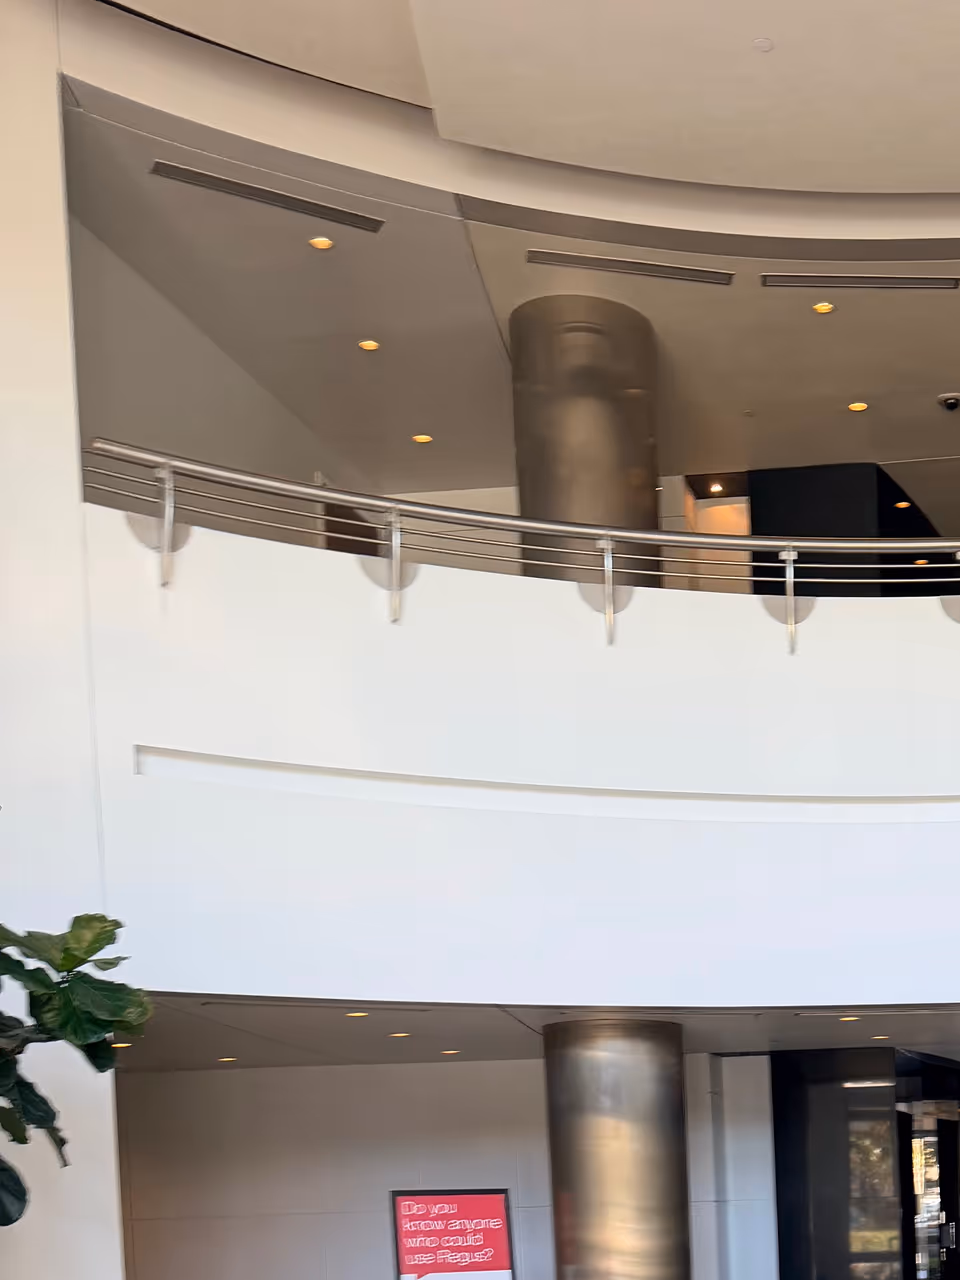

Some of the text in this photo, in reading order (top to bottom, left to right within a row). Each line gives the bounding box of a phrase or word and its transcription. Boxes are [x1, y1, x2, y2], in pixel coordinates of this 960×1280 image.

[401, 1201, 458, 1218] Do you
[402, 1218, 503, 1233] know anyone
[404, 1232, 484, 1248] who could
[405, 1248, 494, 1266] use Regus?
